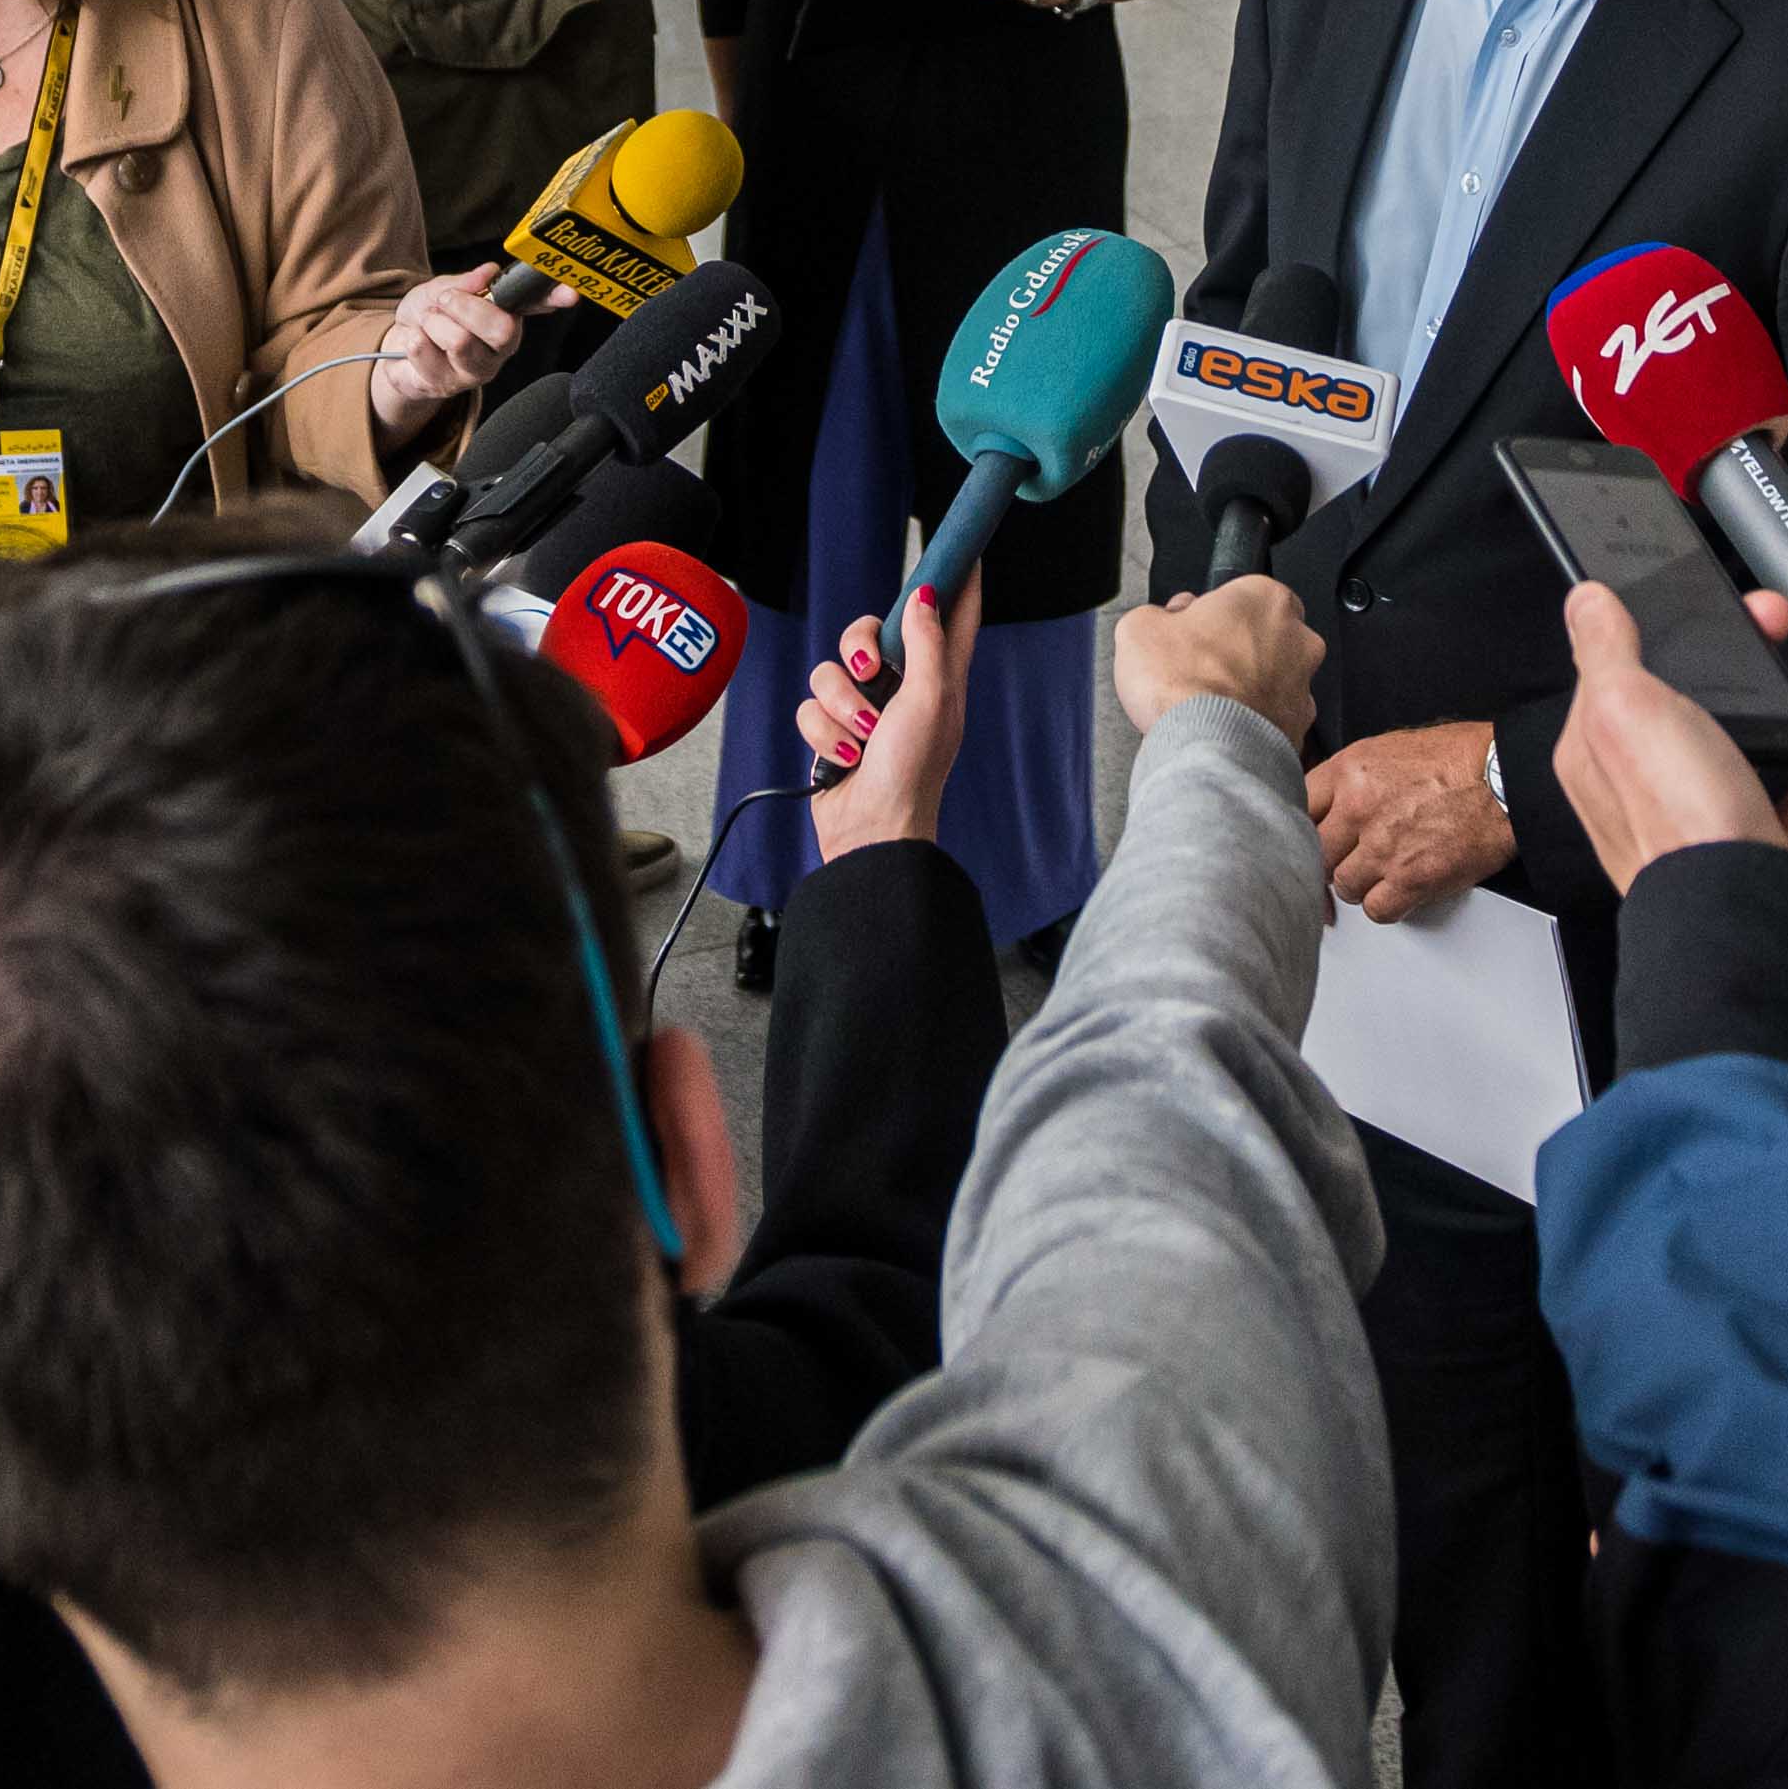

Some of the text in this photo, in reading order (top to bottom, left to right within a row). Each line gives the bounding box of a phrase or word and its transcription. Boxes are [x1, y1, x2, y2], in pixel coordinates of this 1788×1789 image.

[544, 219, 677, 297] Radio KASZËB
[611, 291, 647, 312] FM
[667, 292, 769, 405] MAXXX
[969, 232, 1093, 388] Radio Gdańsk
[1599, 282, 1732, 396] ZET
[1183, 347, 1372, 420] radio eska
[598, 571, 713, 666] TOK FM
